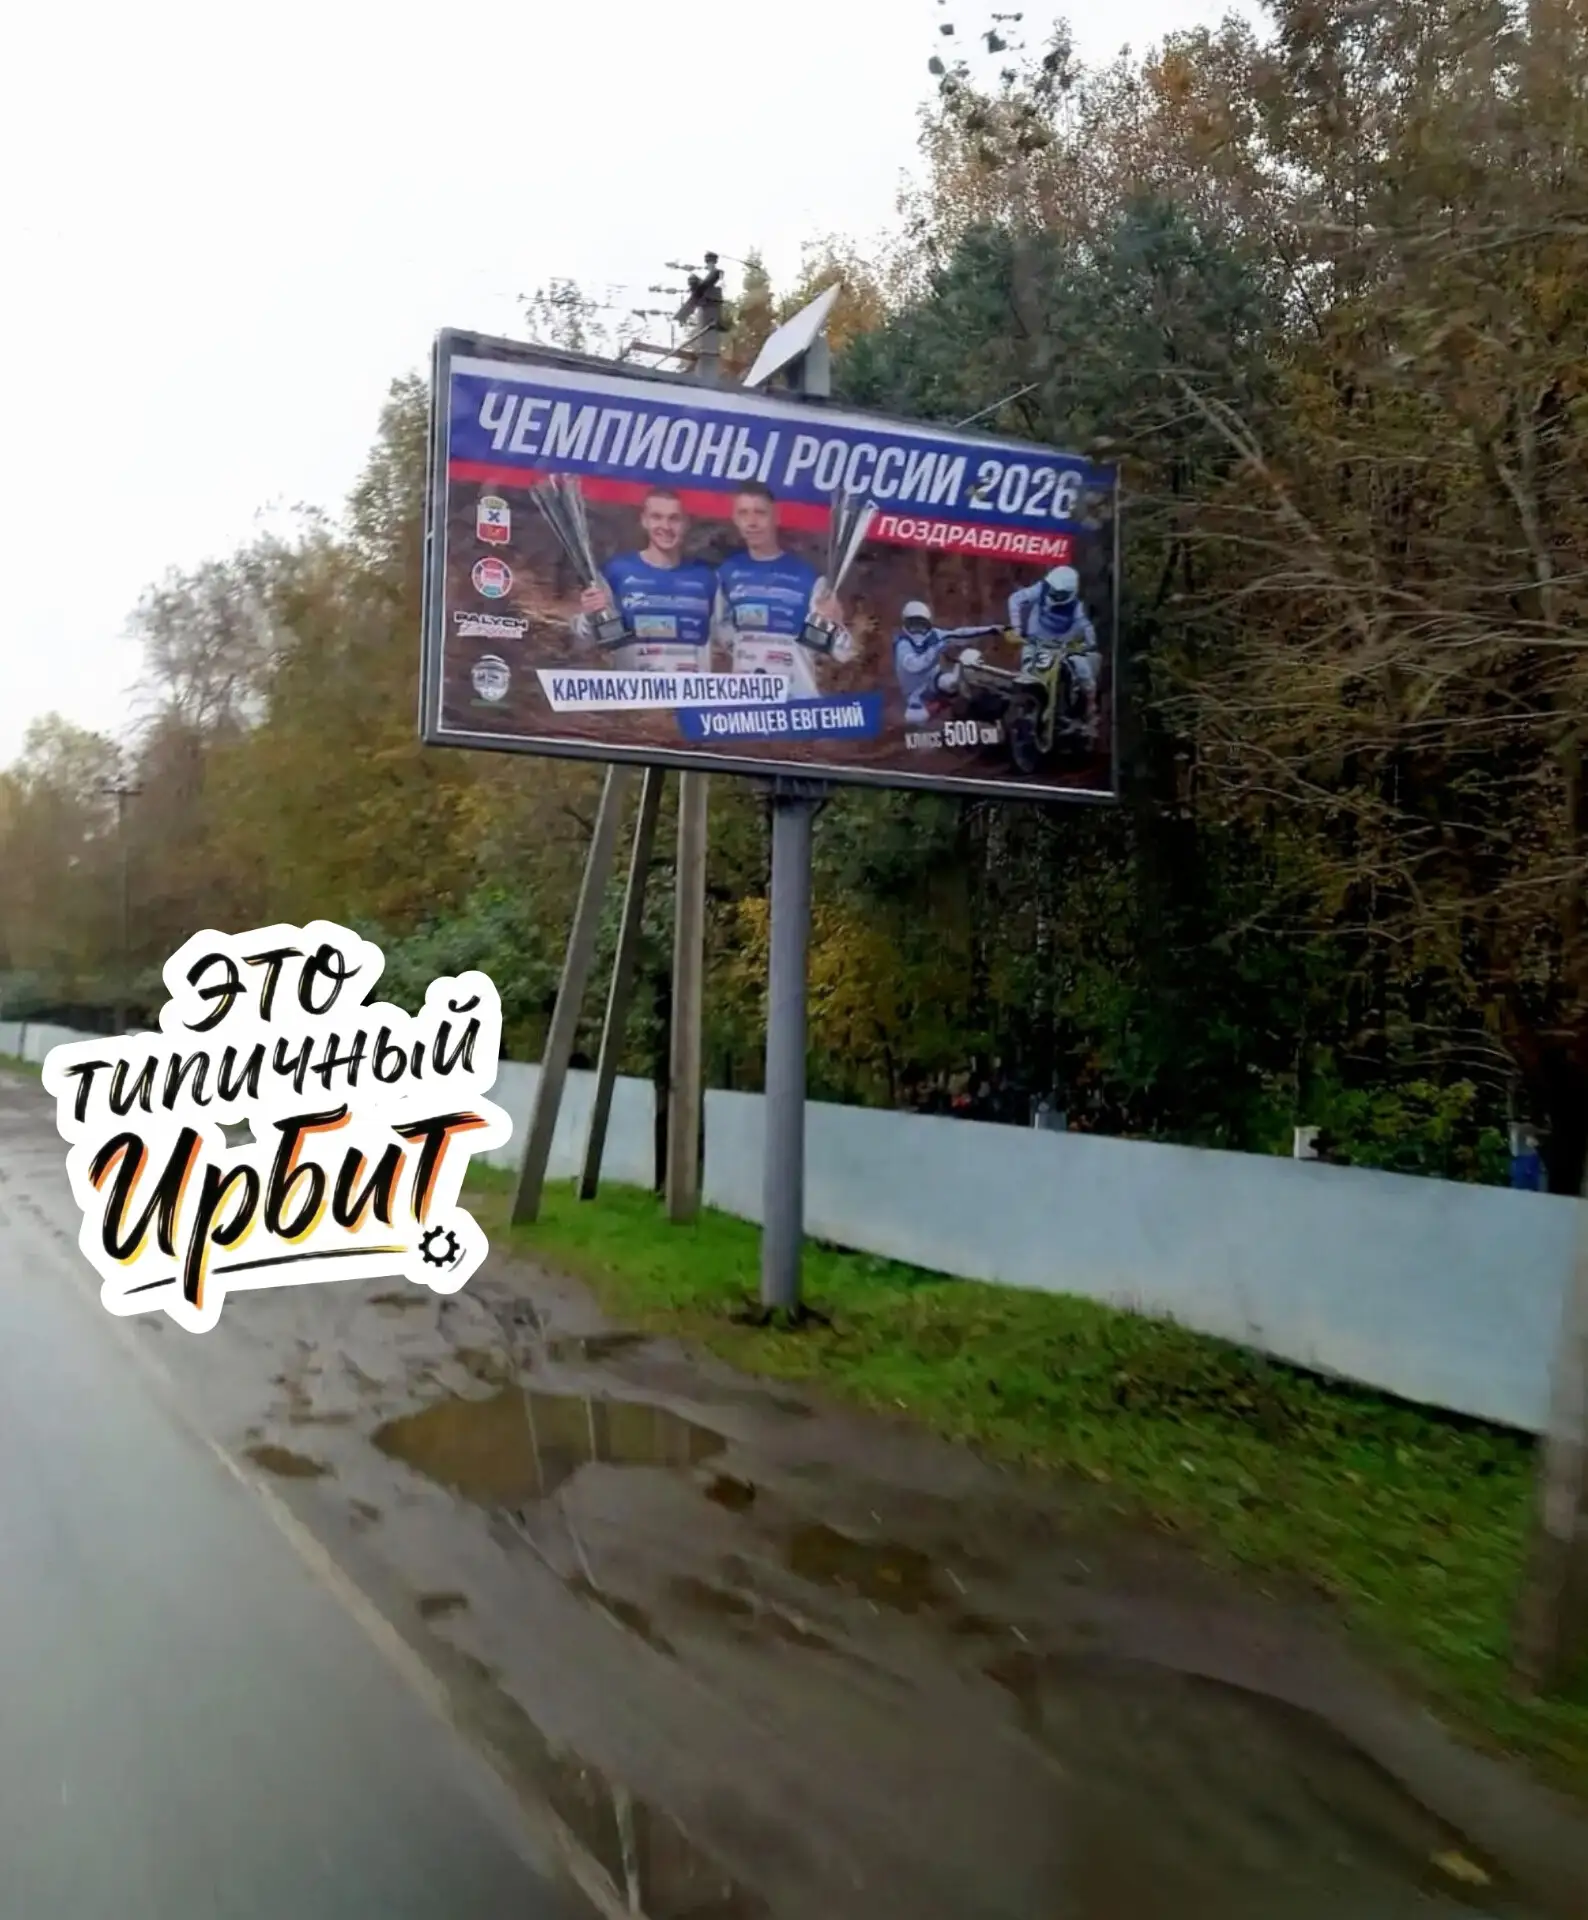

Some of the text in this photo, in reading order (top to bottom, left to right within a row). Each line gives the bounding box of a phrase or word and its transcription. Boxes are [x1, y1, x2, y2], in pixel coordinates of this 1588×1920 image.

[478, 392, 1083, 519] ЧЕМПИОНЫ РОССИИ 2026
[878, 516, 1068, 558] ПОЗДРАВЛЯЕМ!
[552, 676, 784, 702] КАРМАКУЛИН АЛЕКСАНДР
[700, 702, 865, 737] УФИМЦЕВ ЕВГЕНИЙ
[944, 720, 978, 747] 500
